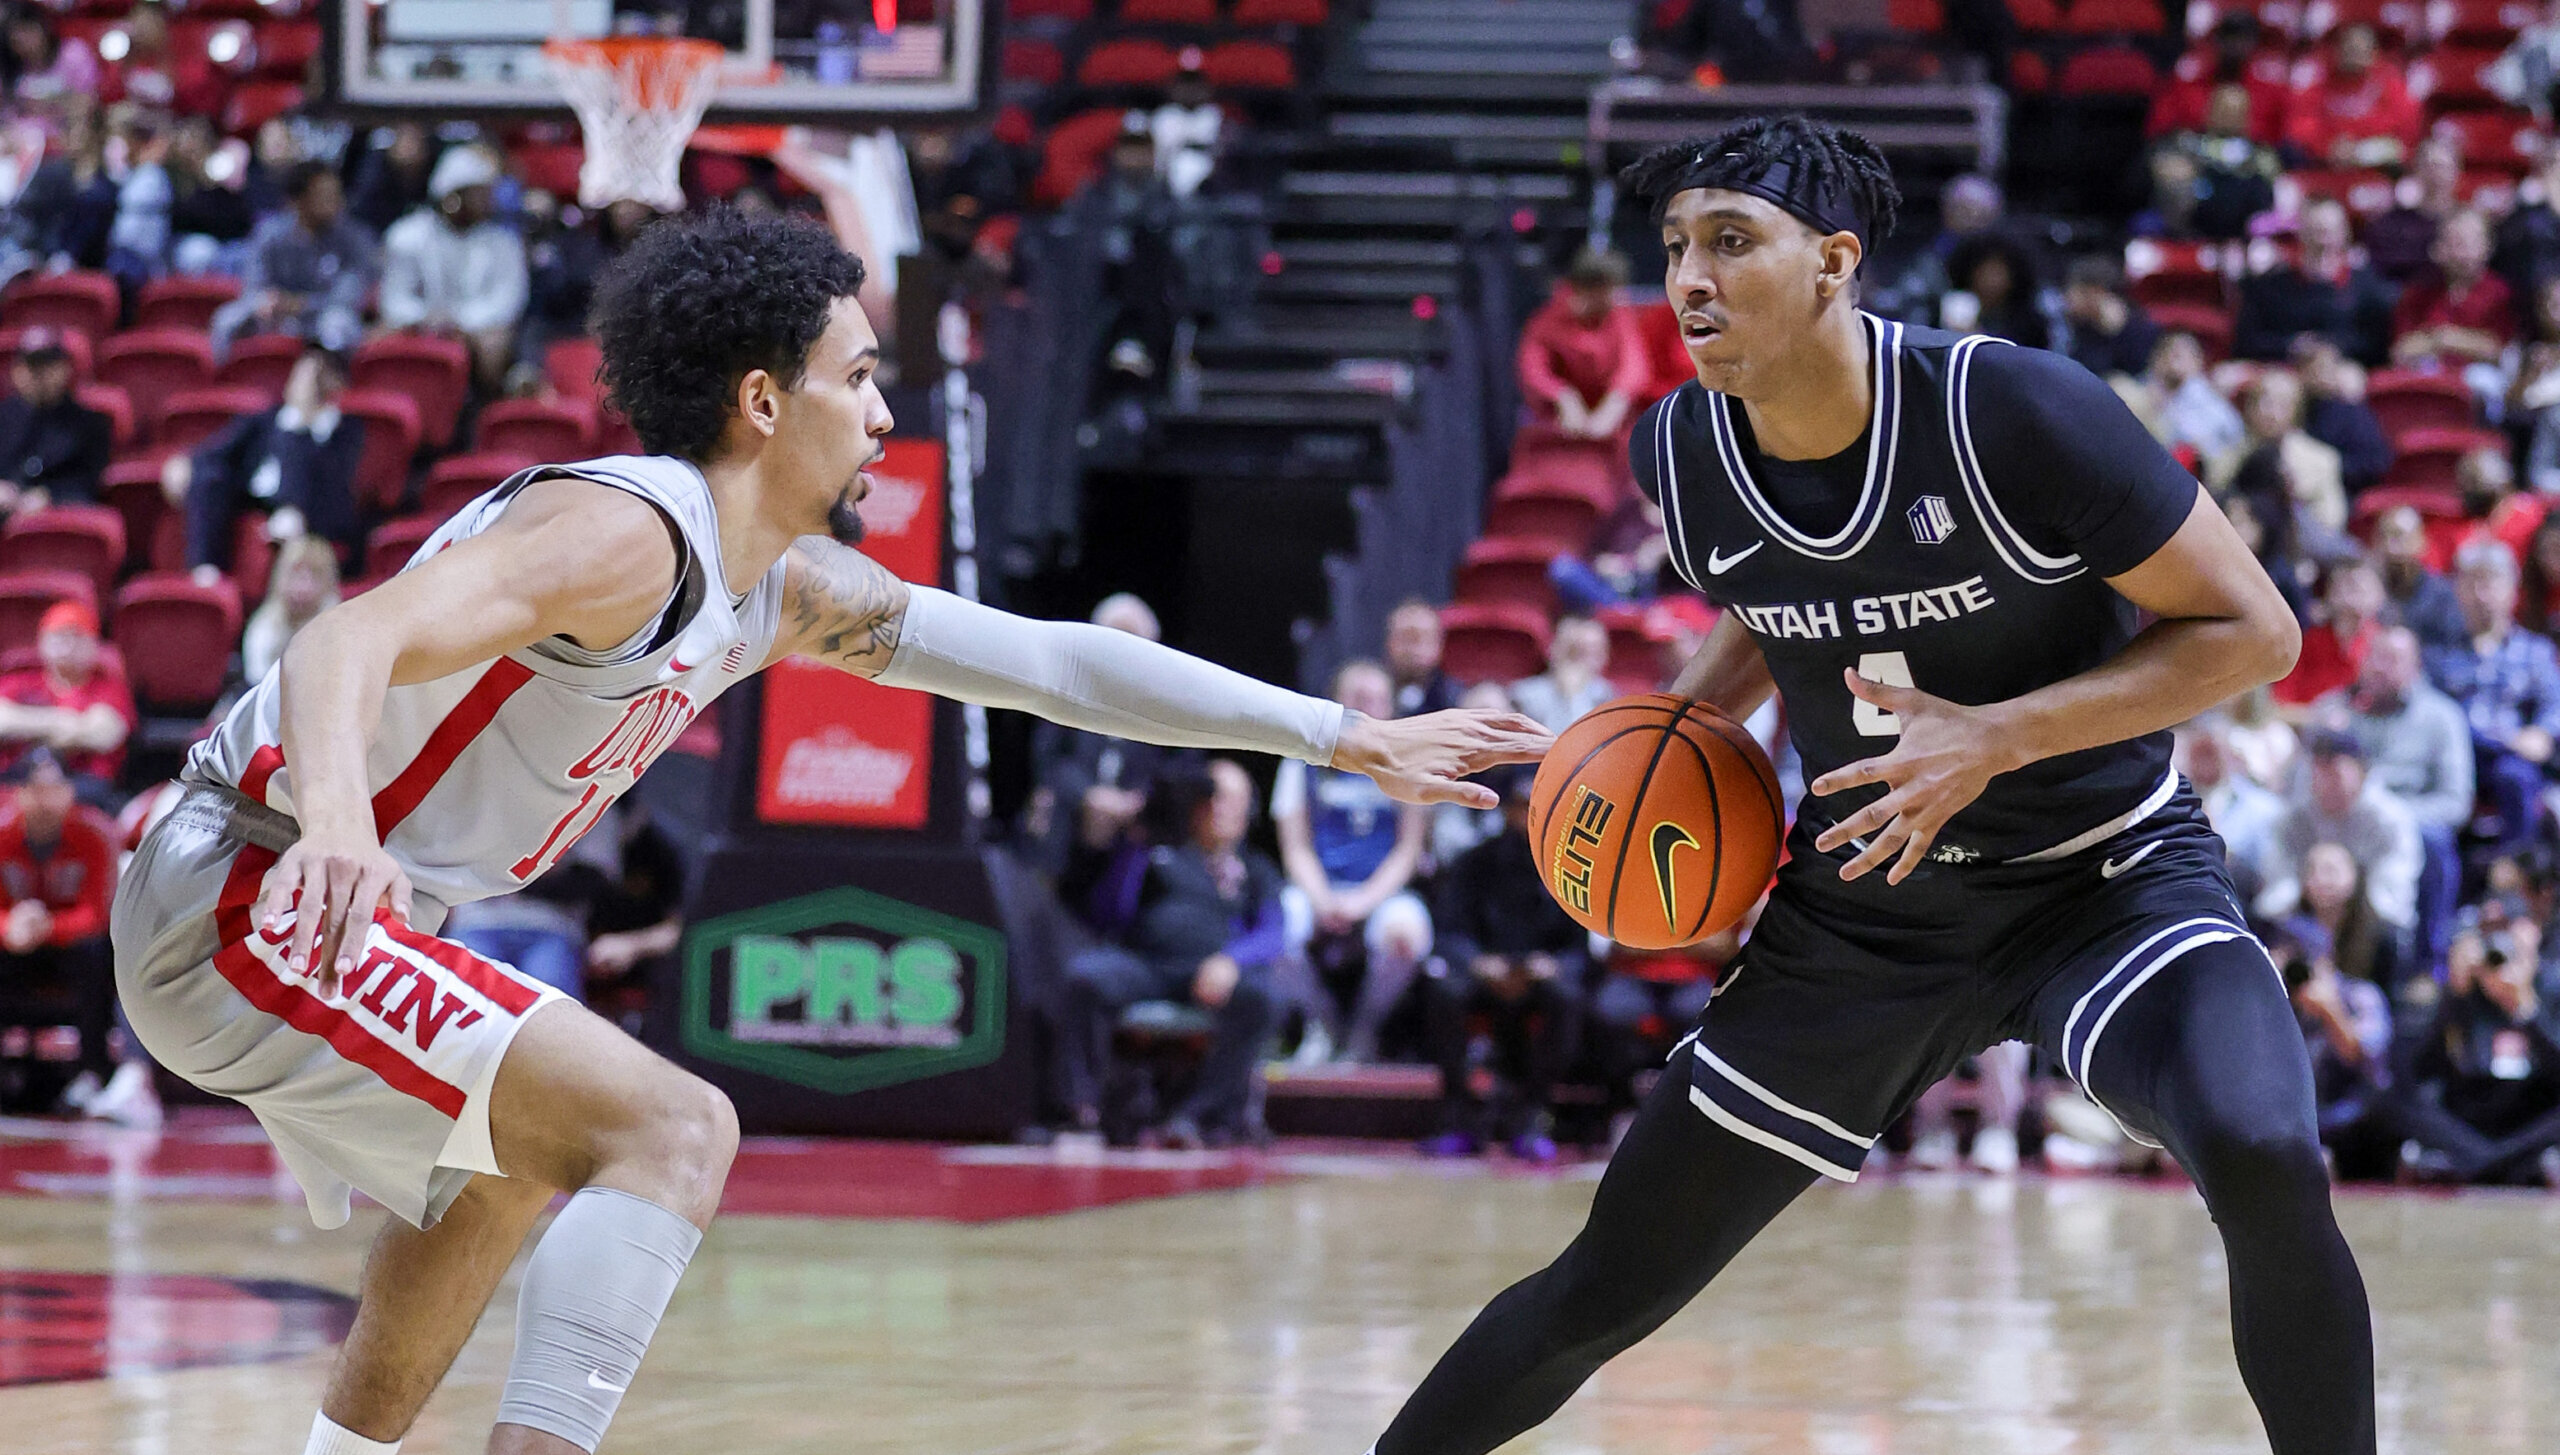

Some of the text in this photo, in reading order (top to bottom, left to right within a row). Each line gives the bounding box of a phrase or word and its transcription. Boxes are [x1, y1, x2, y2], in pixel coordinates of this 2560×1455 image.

[1732, 575, 1996, 639] UTAH STATE
[1561, 788, 1617, 917] ELITE
[733, 937, 962, 1024] PRS
